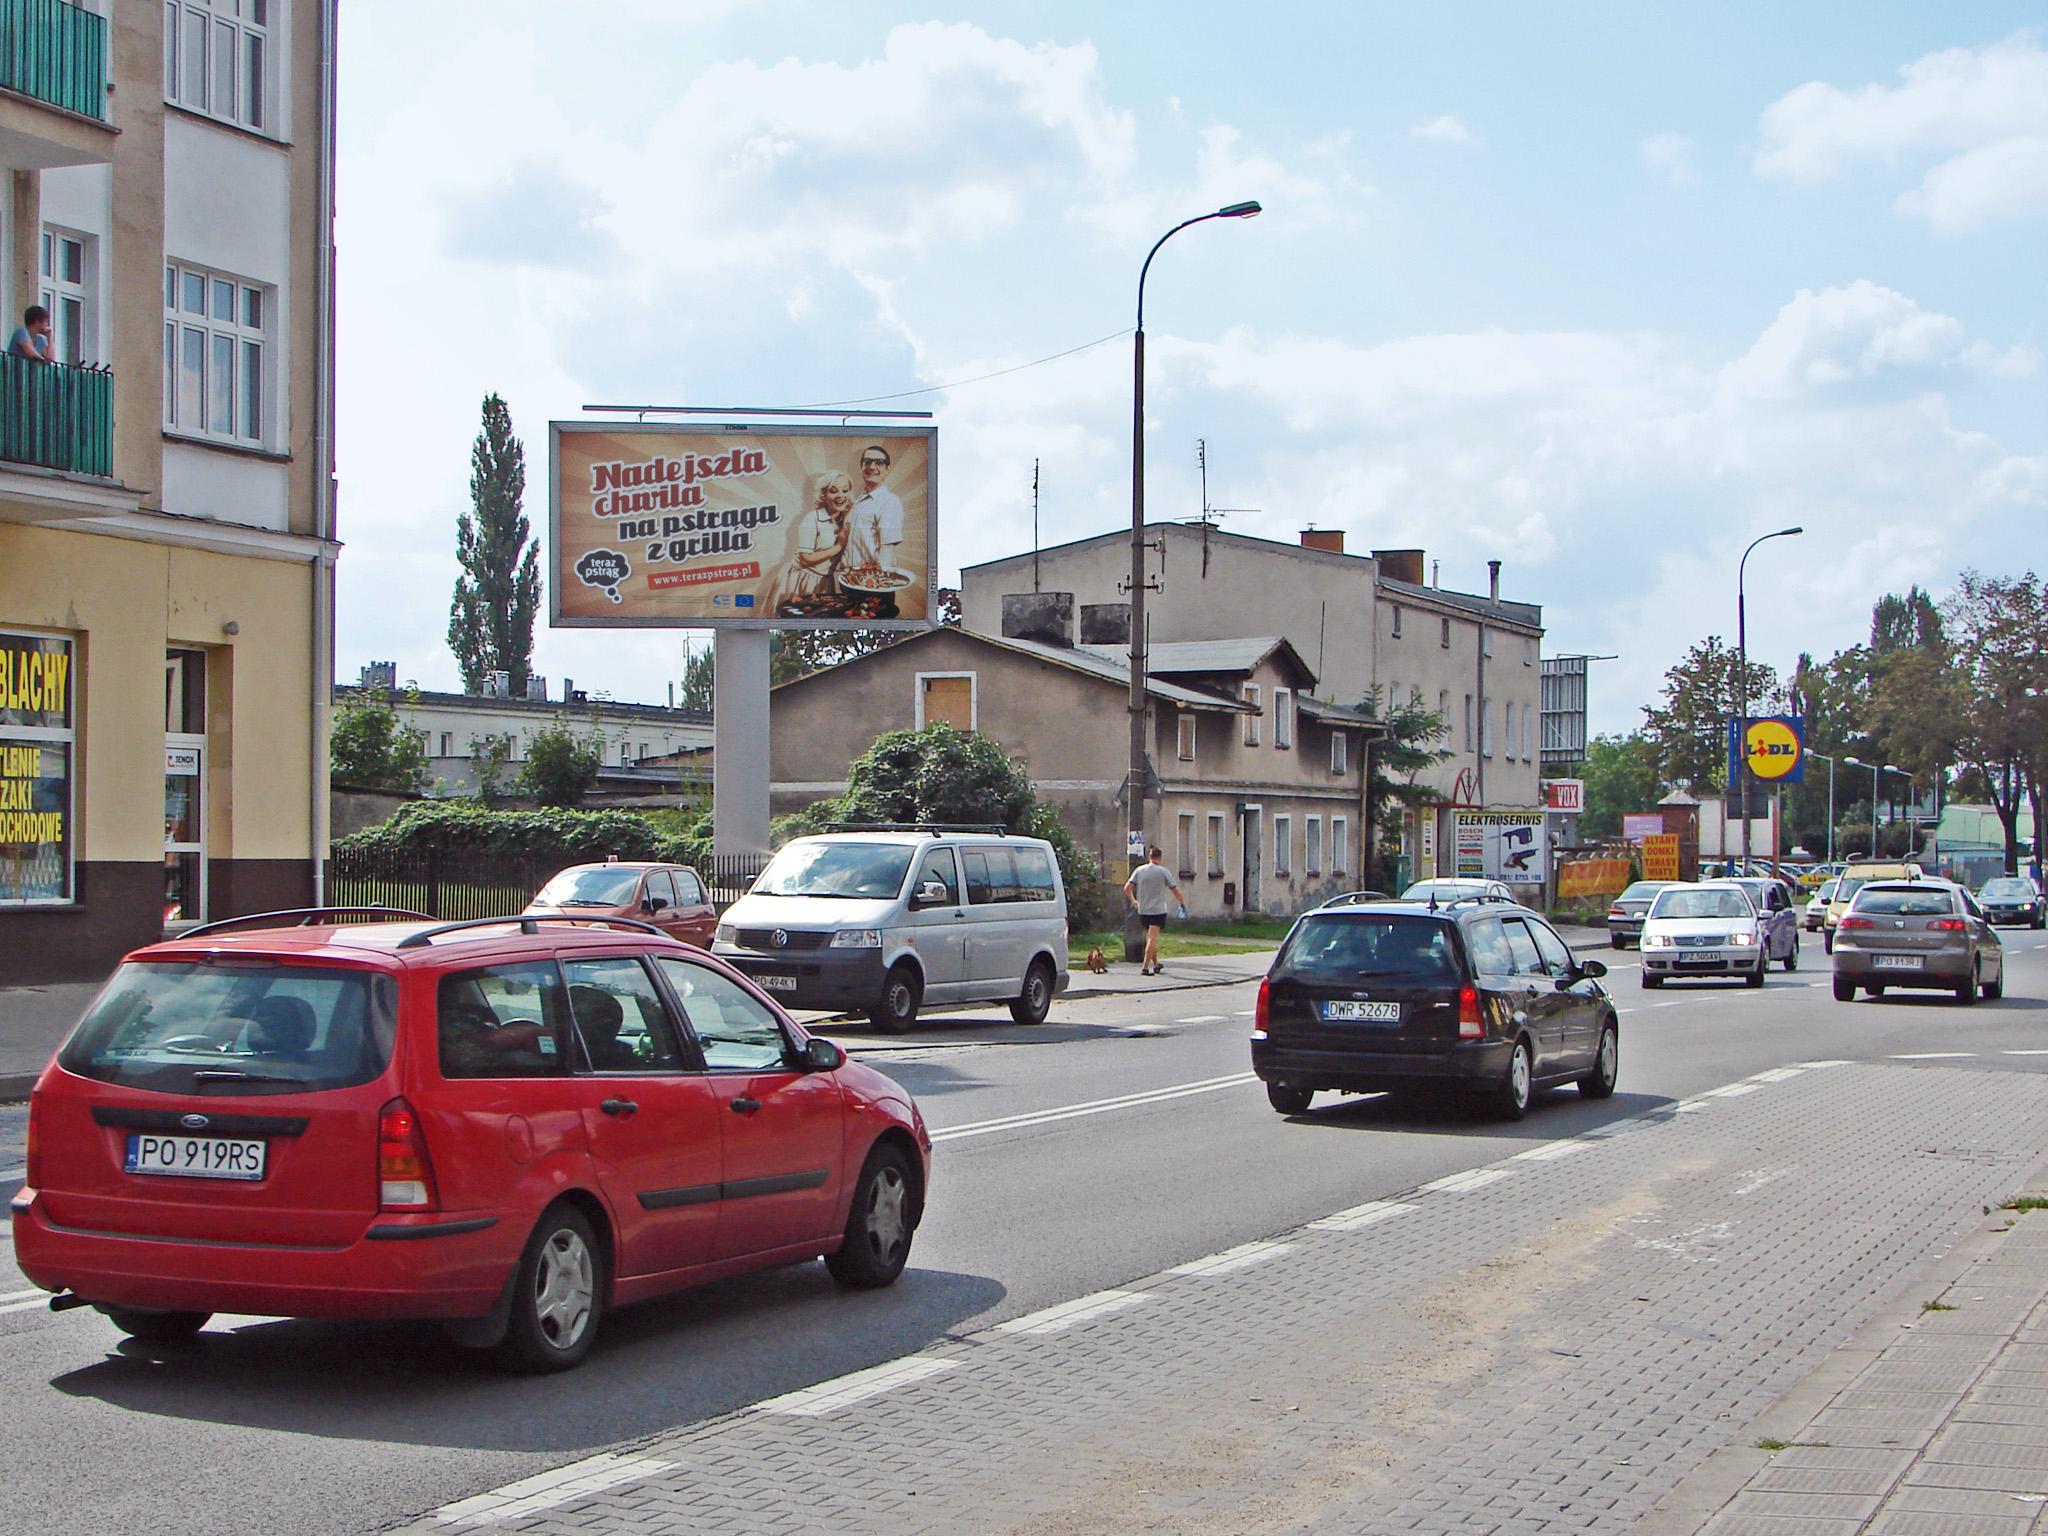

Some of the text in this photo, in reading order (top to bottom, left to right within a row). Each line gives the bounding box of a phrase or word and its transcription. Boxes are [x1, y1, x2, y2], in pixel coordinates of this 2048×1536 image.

[593, 449, 767, 491] Nadejszła
[594, 483, 705, 517] chwila
[619, 518, 659, 540] na
[647, 531, 752, 562] z grilla
[585, 566, 620, 579] pstrąg
[591, 558, 616, 567] teraz
[653, 564, 752, 586] www.terazpstrag.pl
[0, 650, 68, 712] BLACHY
[0, 780, 33, 810] ZAKI
[1557, 786, 1577, 807] VOX
[0, 812, 63, 843] OCHODOWE
[1458, 815, 1542, 826] ELEKTROSERWIS
[1647, 847, 1674, 856] DOMKI
[1330, 1002, 1398, 1018] DWR 52678
[142, 1138, 260, 1170] PO 919RS
